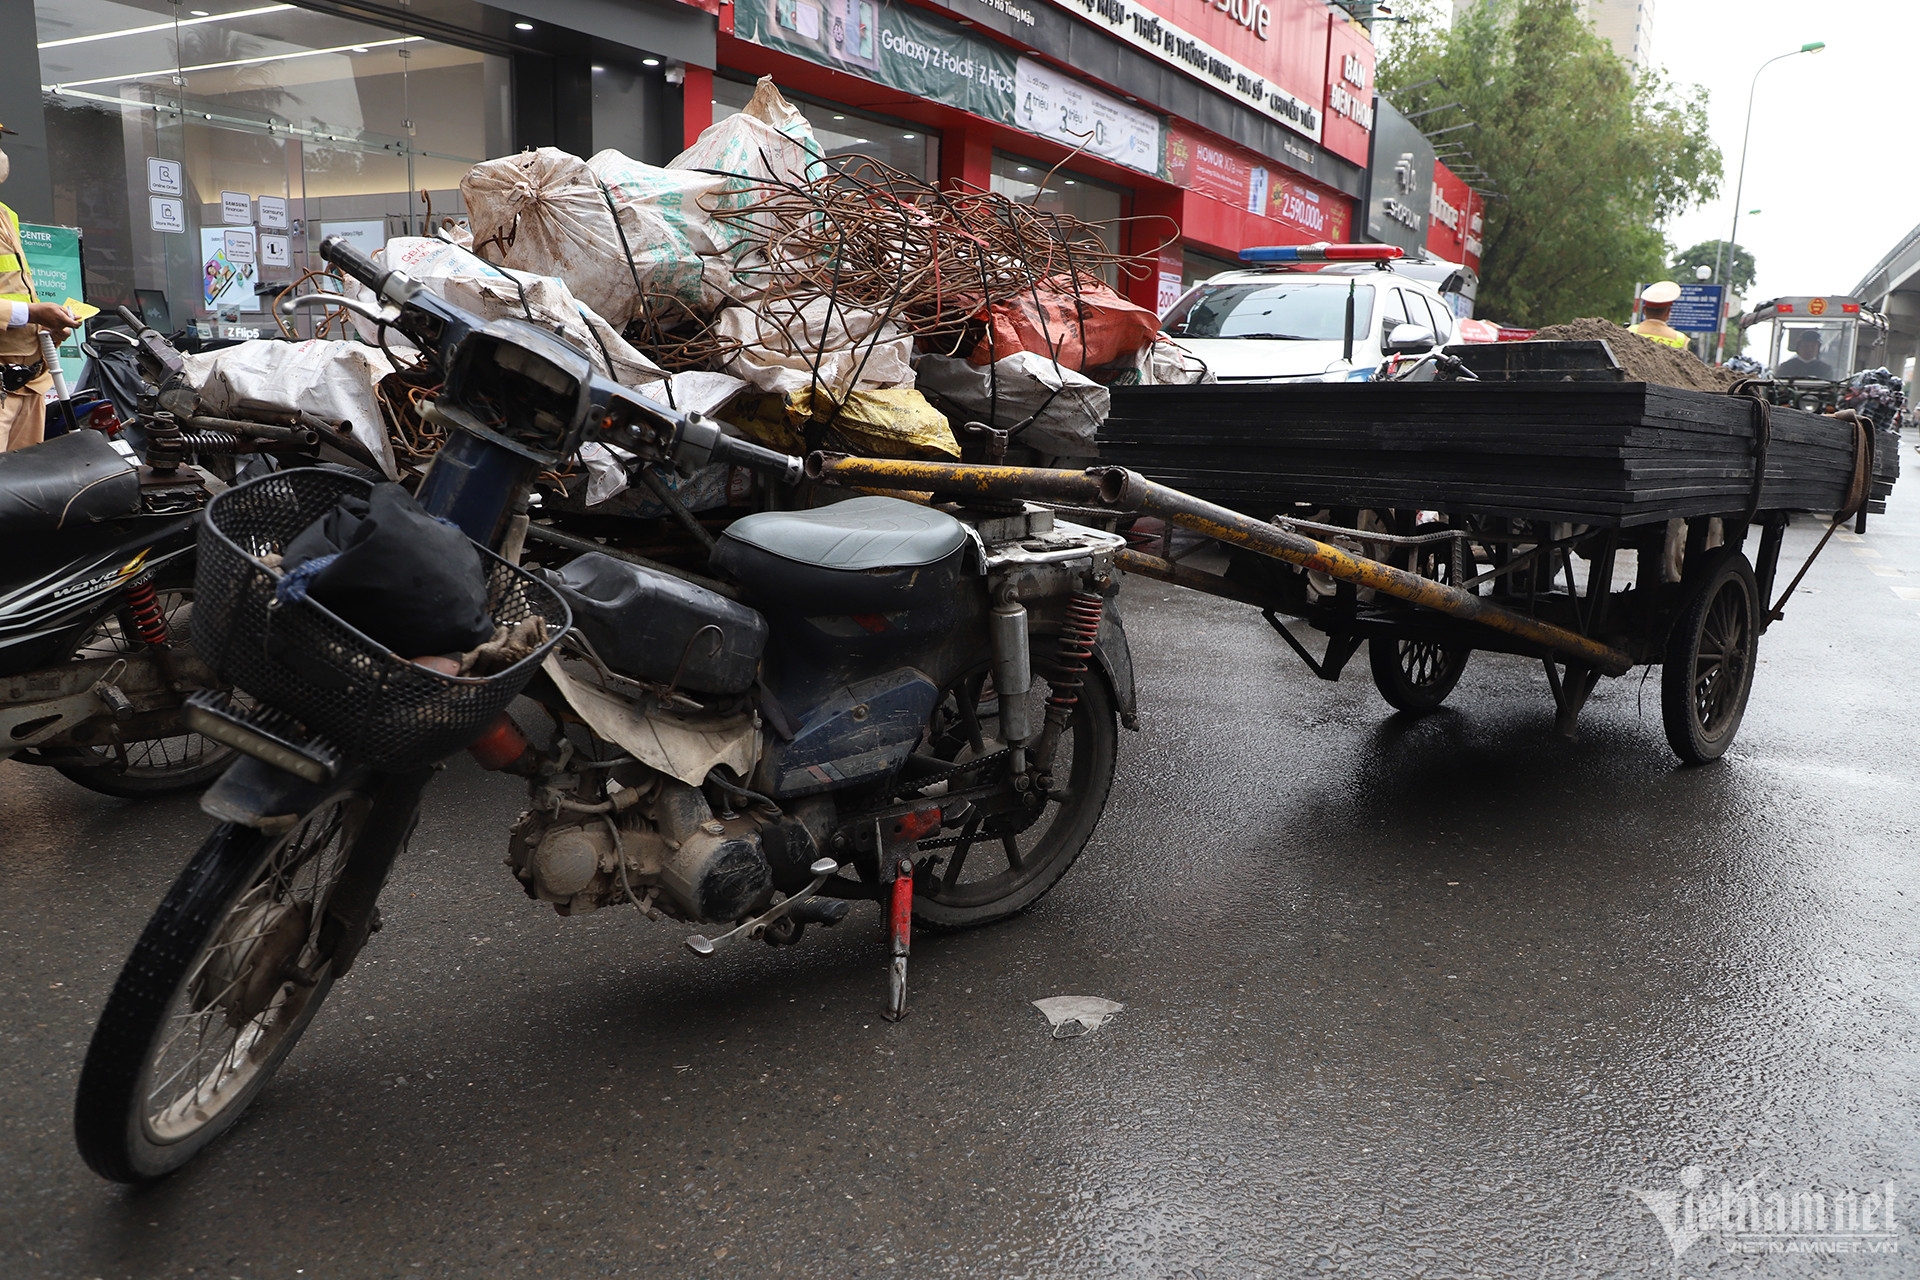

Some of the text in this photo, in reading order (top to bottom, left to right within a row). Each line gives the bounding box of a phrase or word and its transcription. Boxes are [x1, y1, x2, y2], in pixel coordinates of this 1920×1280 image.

[1213, 0, 1271, 41] ore
[882, 29, 1013, 96] Galaxy Z Fold5 Z Flip5
[1133, 12, 1164, 46] THIẾT
[1164, 30, 1174, 57] BỊ
[1176, 37, 1207, 71] THÔNG
[1236, 73, 1252, 95] SIM
[1343, 53, 1366, 90] BÁN
[1023, 91, 1034, 121] 4
[1059, 105, 1068, 133] 3
[1196, 144, 1224, 168] HONOR
[19, 230, 52, 241] CENTER
[25, 240, 52, 248] Samsung
[227, 327, 260, 340] Z Flip5
